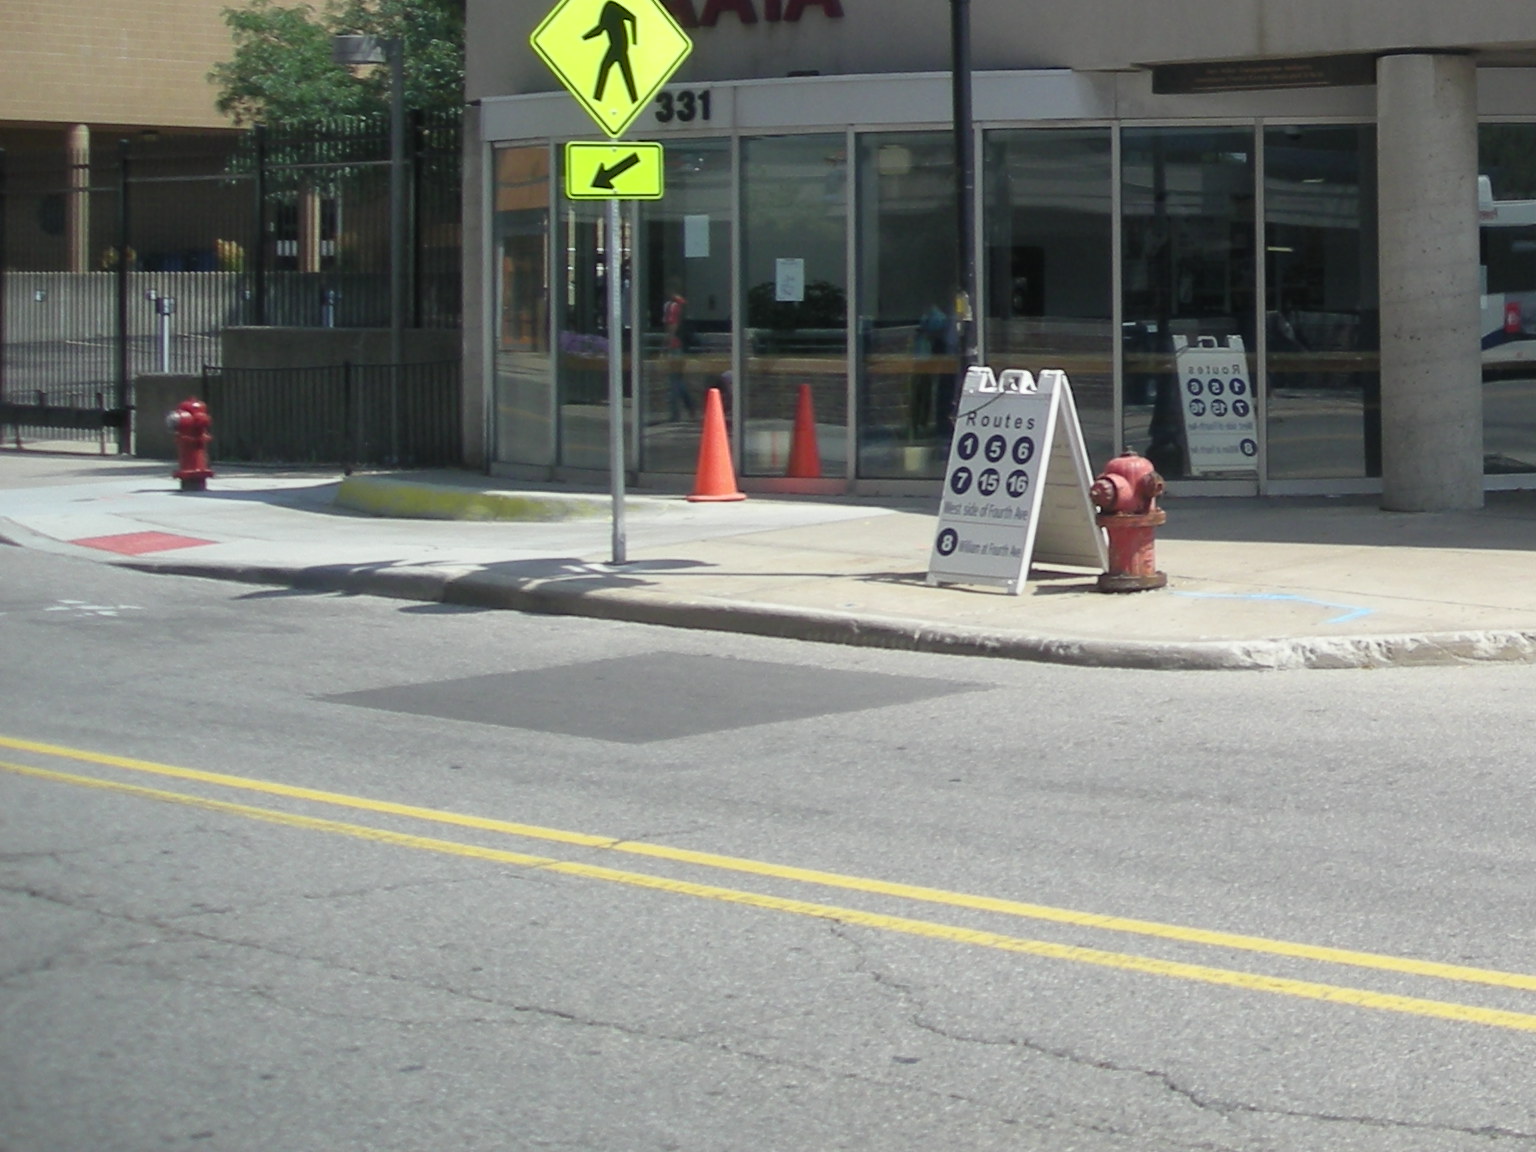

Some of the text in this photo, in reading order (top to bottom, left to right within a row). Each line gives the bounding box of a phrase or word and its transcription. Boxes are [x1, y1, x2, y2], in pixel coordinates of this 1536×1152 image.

[654, 89, 712, 123] 331
[965, 411, 1036, 430] Routes
[989, 440, 1001, 459] 5
[1017, 441, 1030, 460] 6
[978, 474, 998, 492] 15
[1007, 475, 1027, 493] 16
[942, 534, 954, 551] 8
